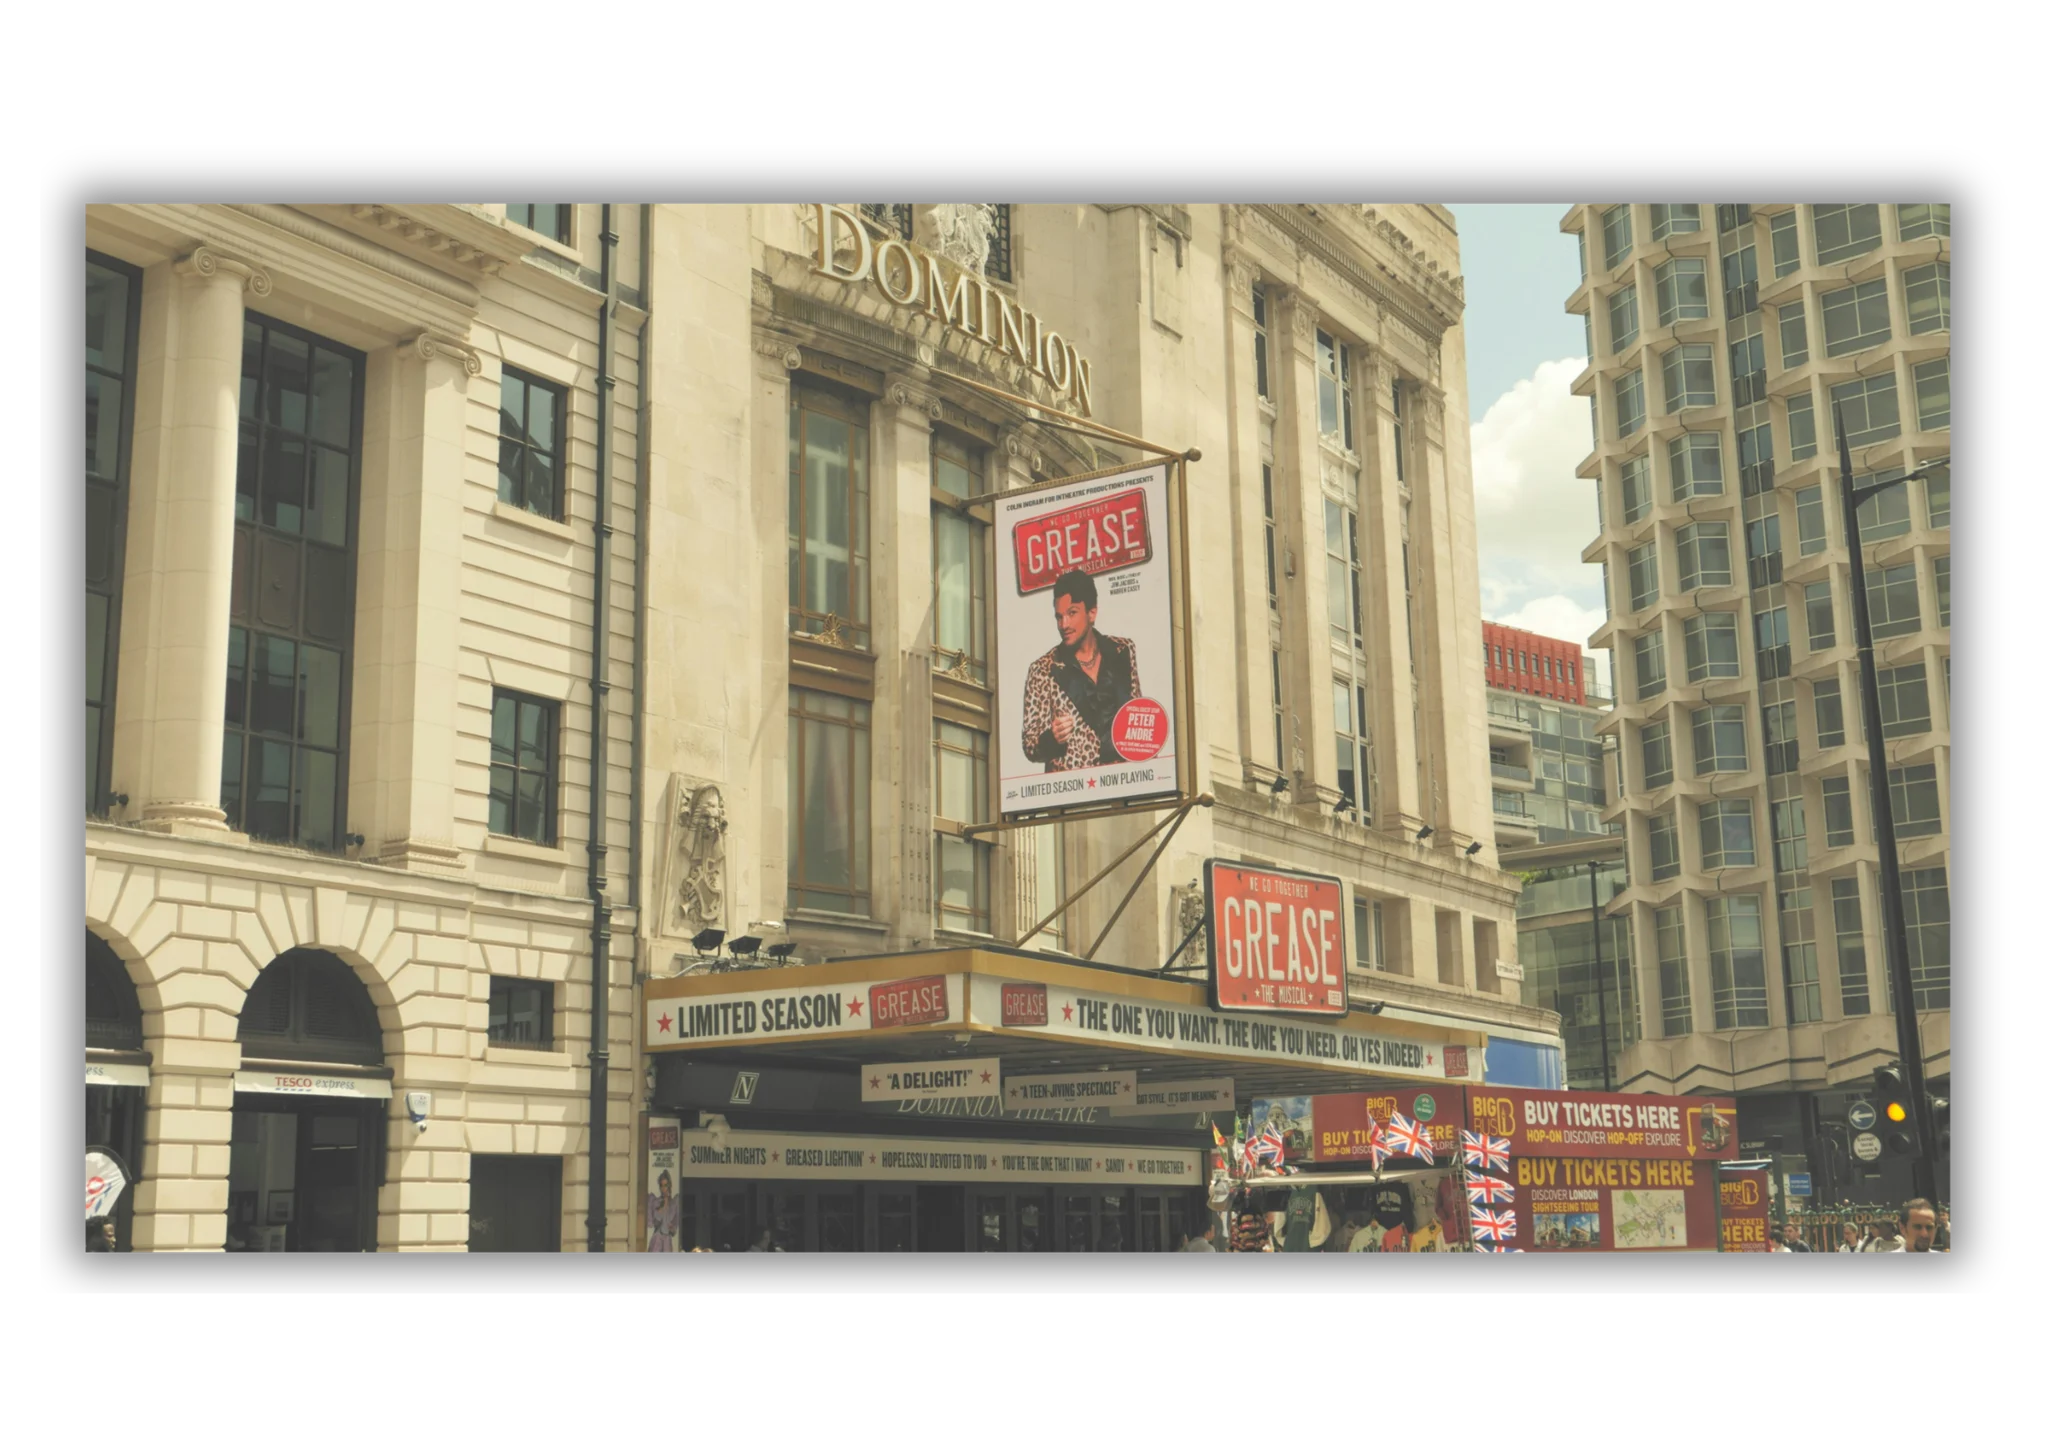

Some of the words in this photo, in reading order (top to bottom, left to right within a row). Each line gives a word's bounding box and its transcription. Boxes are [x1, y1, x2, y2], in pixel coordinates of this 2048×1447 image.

[811, 203, 1092, 417] DOMINION
[1006, 502, 1022, 512] COLIN
[1023, 498, 1044, 508] INGRAM
[1044, 495, 1056, 504] FOR
[1086, 482, 1125, 496] PRODUCTIONS
[1125, 475, 1154, 488] PRESENTS
[1074, 504, 1109, 520] TOGETHER
[1027, 508, 1140, 574] GREASE
[1128, 713, 1155, 727] PETER
[1125, 727, 1154, 741] ANDRE
[1020, 782, 1051, 798] LIMITED
[1053, 779, 1084, 794] SEASON
[1100, 773, 1119, 787] NOW
[1120, 769, 1154, 785] PLAYING
[1250, 877, 1258, 891] WE
[1262, 879, 1271, 893] GO
[1275, 880, 1308, 898] TOGETHER
[1224, 896, 1337, 985] GREASE
[1261, 984, 1275, 1004] THE
[1279, 986, 1309, 1005] MUSICAL
[678, 1000, 756, 1038] LIMITED
[762, 992, 841, 1032] SEASON
[877, 983, 943, 1020] GREASE
[1006, 993, 1045, 1016] GREASE
[1077, 998, 1108, 1032] THE
[1112, 1003, 1142, 1036] ONE
[1146, 1007, 1175, 1040] YOU
[1178, 1012, 1221, 1045] WANT.
[1223, 1018, 1249, 1048] THE
[1250, 1022, 1277, 1052] ONE
[1279, 1026, 1303, 1056] YOU
[1342, 1035, 1359, 1062] OH
[1359, 1037, 1381, 1065] YES
[1383, 1041, 1424, 1069] INDEED!
[275, 1077, 312, 1087] TESCO
[315, 1080, 355, 1092] express
[903, 1069, 973, 1090] DELIGHT!”
[1030, 1083, 1075, 1099] TEEN-JIVING
[1076, 1080, 1121, 1097] SPECTACLE”
[1180, 1091, 1191, 1102] GOT
[1191, 1090, 1219, 1102] MEANING”
[1367, 1097, 1384, 1109] BIG
[1473, 1097, 1496, 1117] BIG
[1524, 1100, 1558, 1125] BUY
[1563, 1102, 1633, 1129] TICKETS
[1636, 1106, 1680, 1130] HERE
[1323, 1131, 1350, 1146] BUY
[1427, 1124, 1454, 1140] ERE
[1527, 1129, 1562, 1143] HOP-ON
[1563, 1130, 1606, 1145] DISCOVER
[1607, 1131, 1644, 1145] HOP-OFF
[1645, 1133, 1681, 1146] EXPLORE
[1323, 1147, 1351, 1156] HOP-ON
[1351, 1145, 1372, 1155] DISCO
[1431, 1140, 1454, 1151] PLORE
[733, 1147, 767, 1166] NIGHTS
[786, 1148, 823, 1167] GREASED
[825, 1150, 865, 1167] LIGHTNIN'
[882, 1151, 928, 1169] HOPELESSLY
[929, 1153, 962, 1170] DEVOTED
[962, 1153, 971, 1170] TO
[971, 1154, 987, 1170] YOU
[1002, 1155, 1026, 1171] YOU'RE
[1026, 1156, 1039, 1172] THE
[1040, 1156, 1053, 1172] ONE
[1054, 1156, 1070, 1172] THAT
[1075, 1157, 1092, 1173] WANT
[1105, 1158, 1124, 1173] SANDY
[1137, 1159, 1146, 1173] WE
[1147, 1159, 1156, 1174] GO
[1156, 1160, 1184, 1174] TOGETHER
[1518, 1158, 1557, 1186] BUY
[1562, 1158, 1641, 1186] TICKETS
[1645, 1160, 1694, 1186] HERE
[1531, 1189, 1567, 1201] DISCOVER
[1569, 1189, 1599, 1201] LONDON
[1720, 1182, 1741, 1193] BIG
[1532, 1202, 1579, 1213] SIGHTSEEING
[1580, 1202, 1599, 1212] TOUR
[1720, 1193, 1742, 1205] BUS
[1735, 1218, 1764, 1226] TICKETS
[1722, 1225, 1765, 1242] HERE
